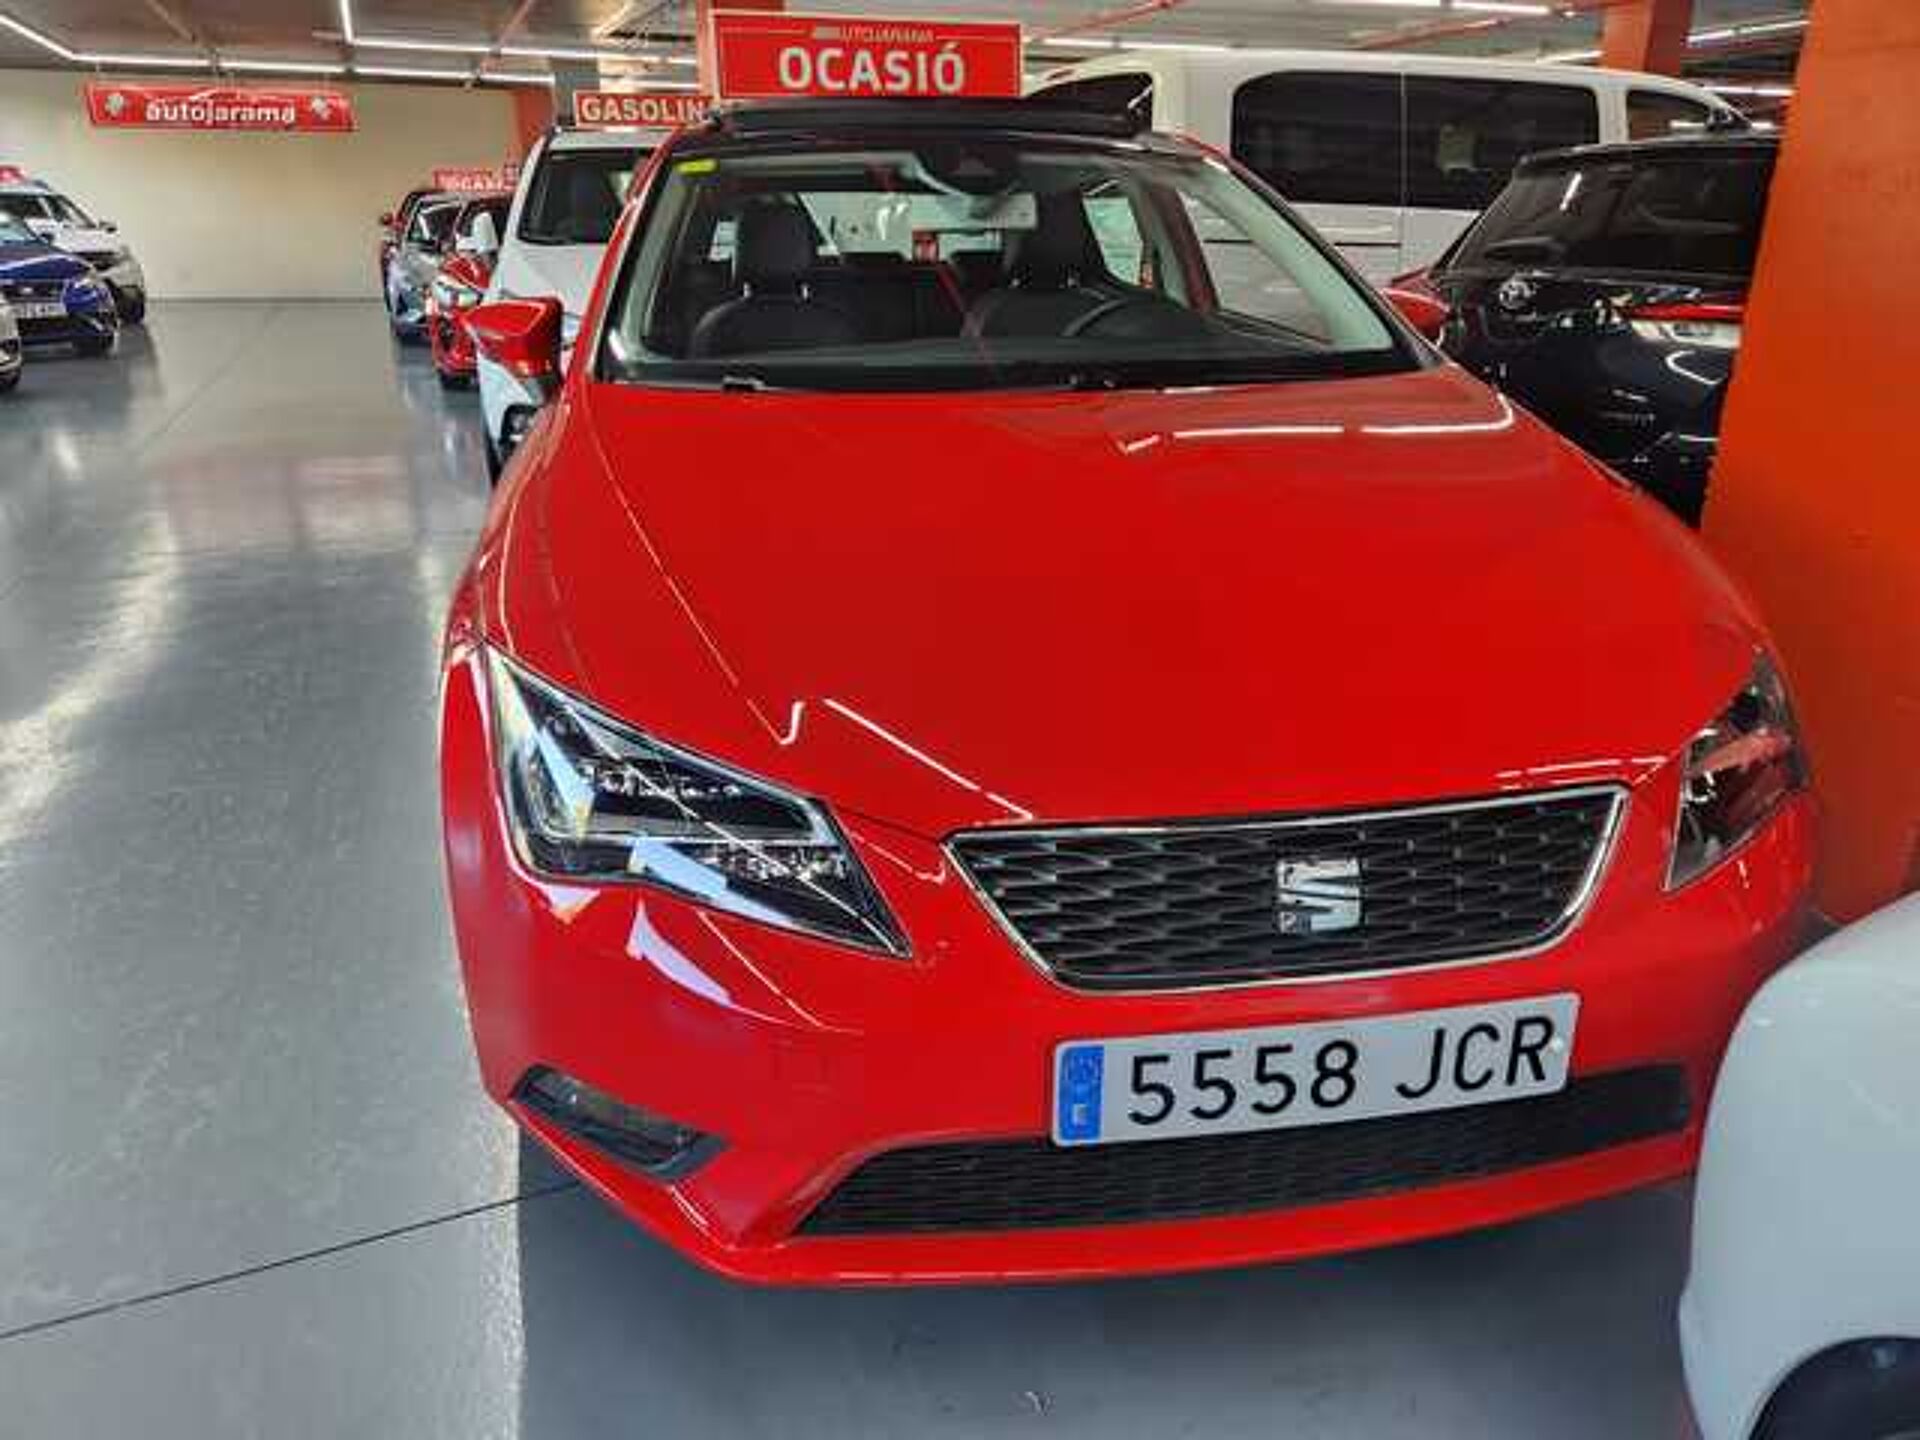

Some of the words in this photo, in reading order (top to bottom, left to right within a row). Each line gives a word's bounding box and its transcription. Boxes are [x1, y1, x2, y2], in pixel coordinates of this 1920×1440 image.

[779, 42, 965, 93] OCASIÓ
[1128, 1040, 1359, 1126] 5558
[1395, 1015, 1555, 1100] JCR
